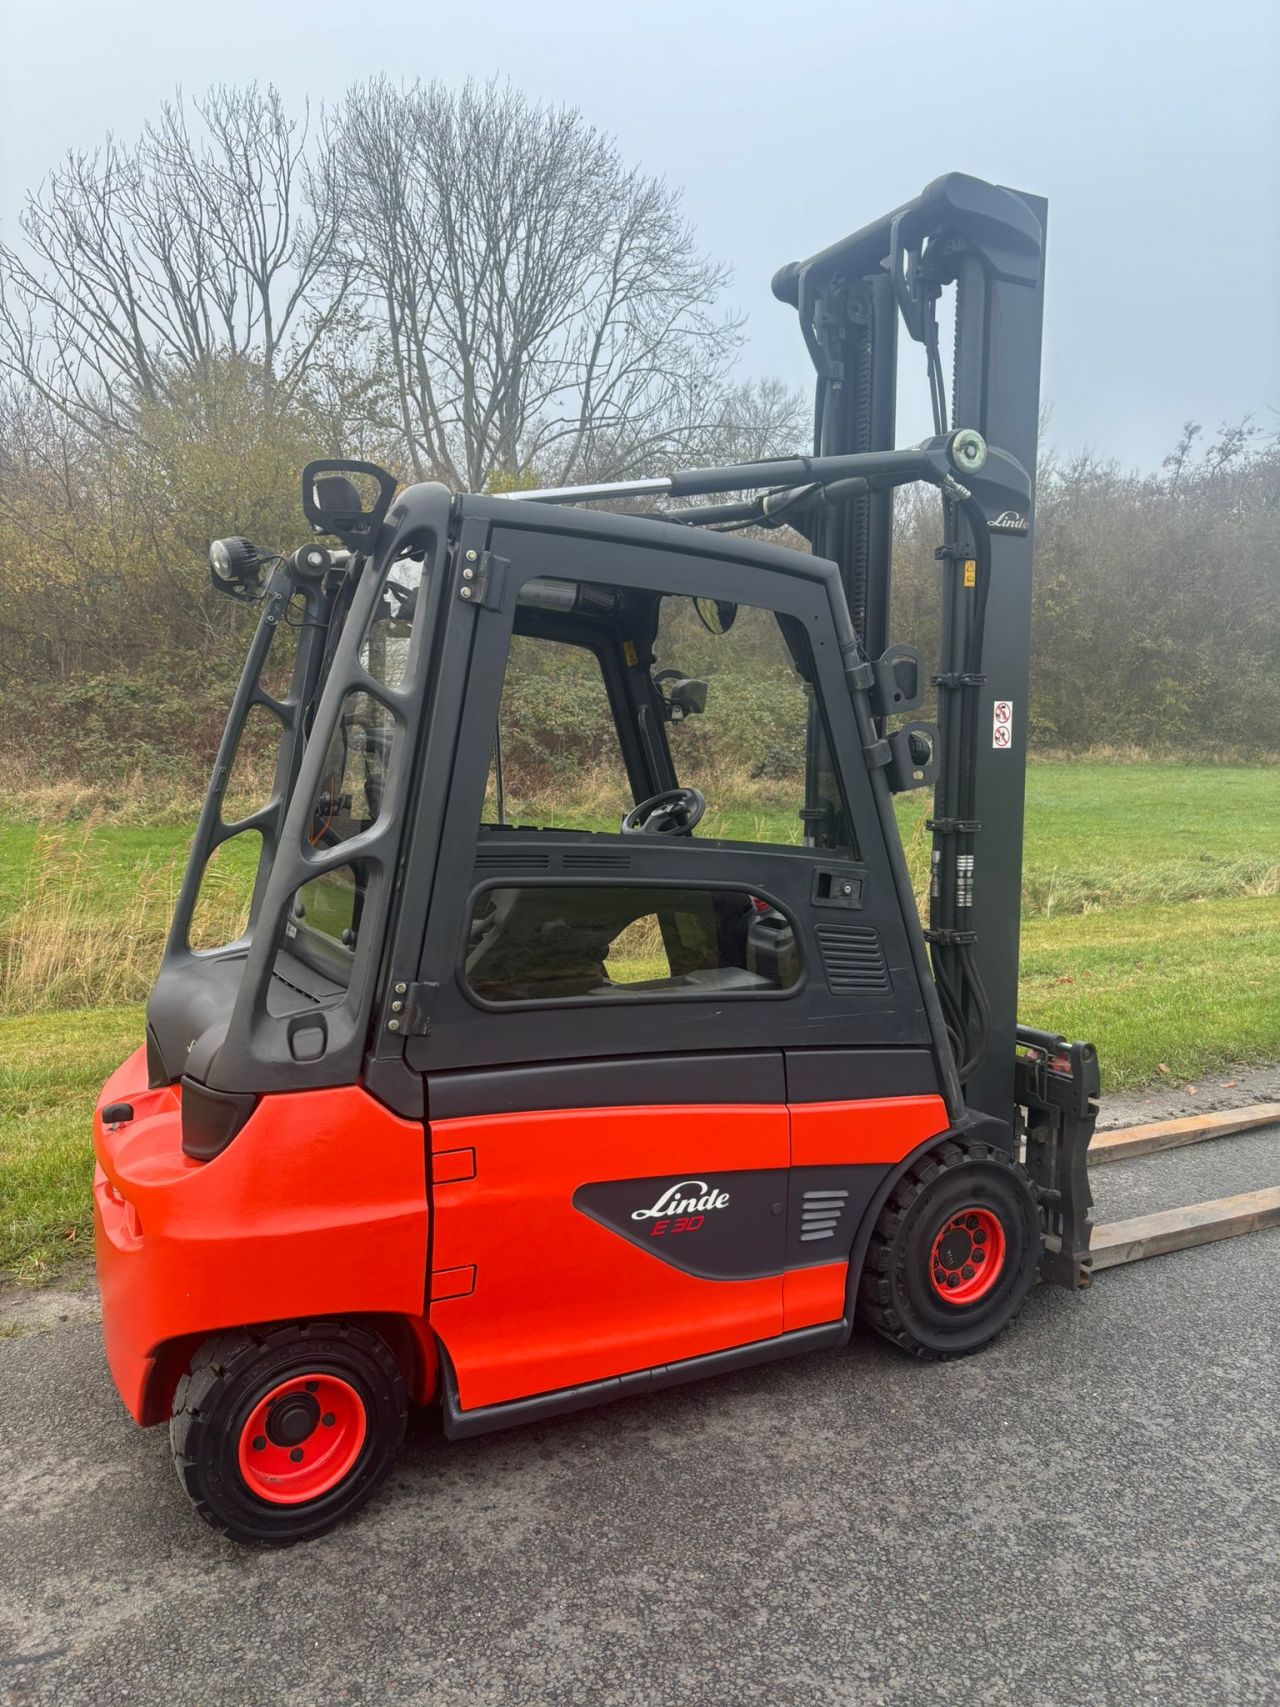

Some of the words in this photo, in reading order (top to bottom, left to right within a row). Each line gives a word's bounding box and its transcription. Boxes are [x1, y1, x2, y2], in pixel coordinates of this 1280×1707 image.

[987, 511, 1029, 529] Linde
[631, 1181, 730, 1220] Linde
[650, 1219, 671, 1237] E
[671, 1215, 705, 1234] 30
